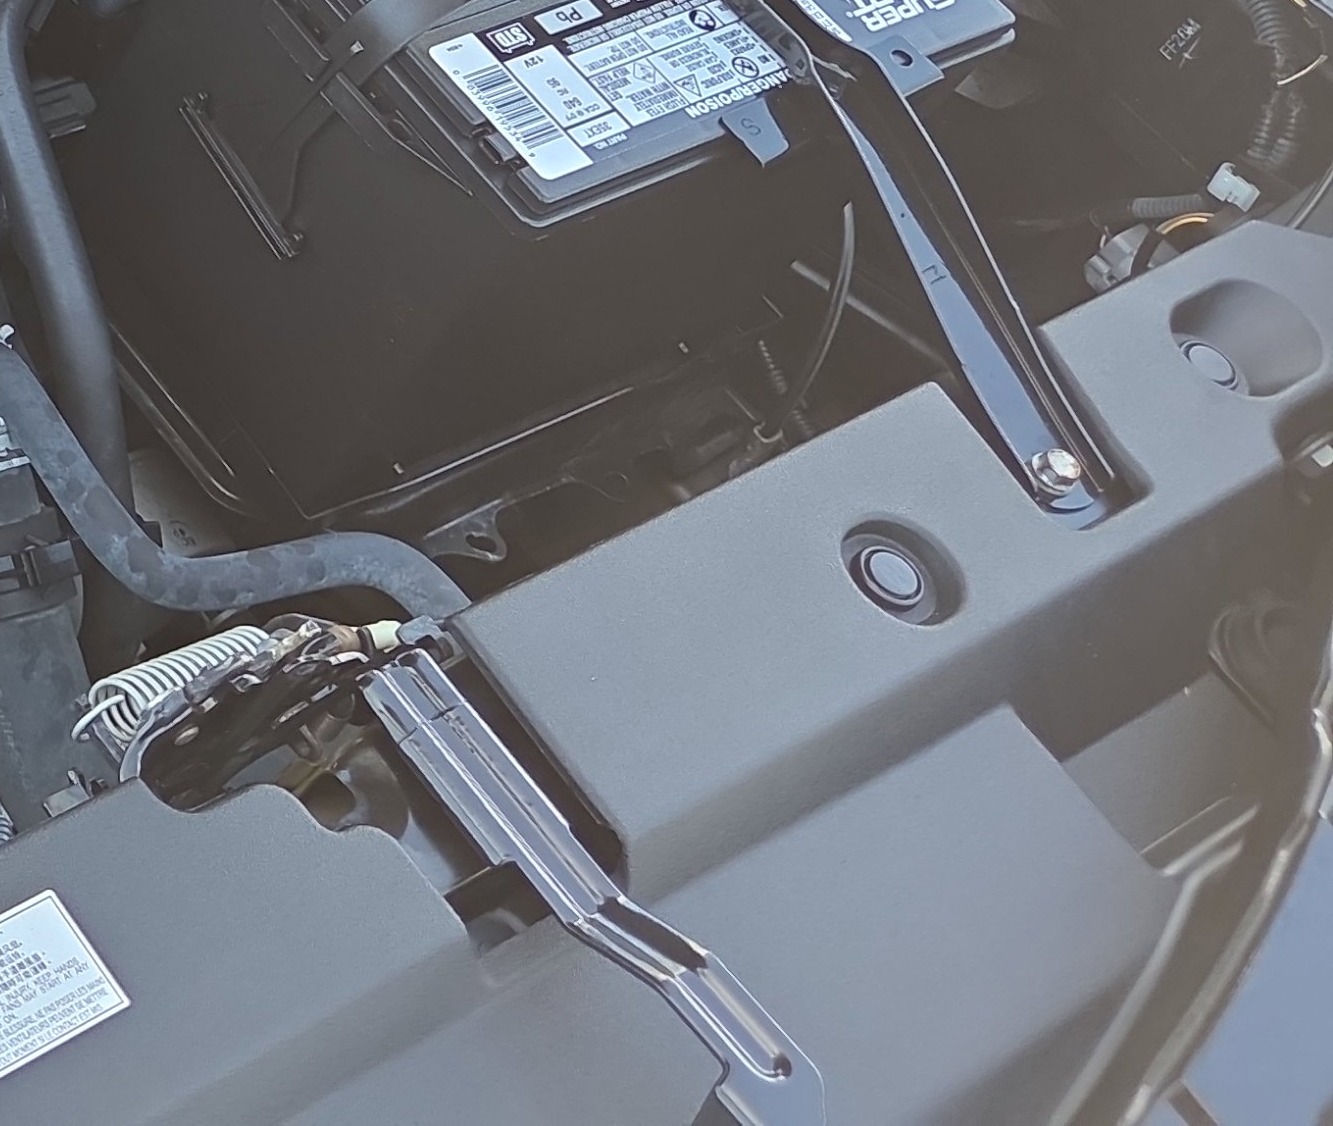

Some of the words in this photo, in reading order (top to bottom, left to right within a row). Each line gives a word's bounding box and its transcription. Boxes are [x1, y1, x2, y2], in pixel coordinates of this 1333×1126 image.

[555, 6, 583, 23] Pb
[494, 27, 527, 47] STD
[523, 55, 543, 68] 12V
[546, 77, 560, 88] 95
[562, 96, 582, 109] 640
[633, 89, 678, 111] IMMEDIATELY
[606, 133, 627, 145] PART
[32, 971, 52, 986] KEEP
[52, 956, 79, 974] HANDS
[1, 999, 22, 1013] FANS
[20, 989, 37, 1002] MAY
[37, 975, 63, 995] START
[63, 970, 73, 980] AT
[74, 962, 89, 975] ANY
[74, 985, 88, 997] LES
